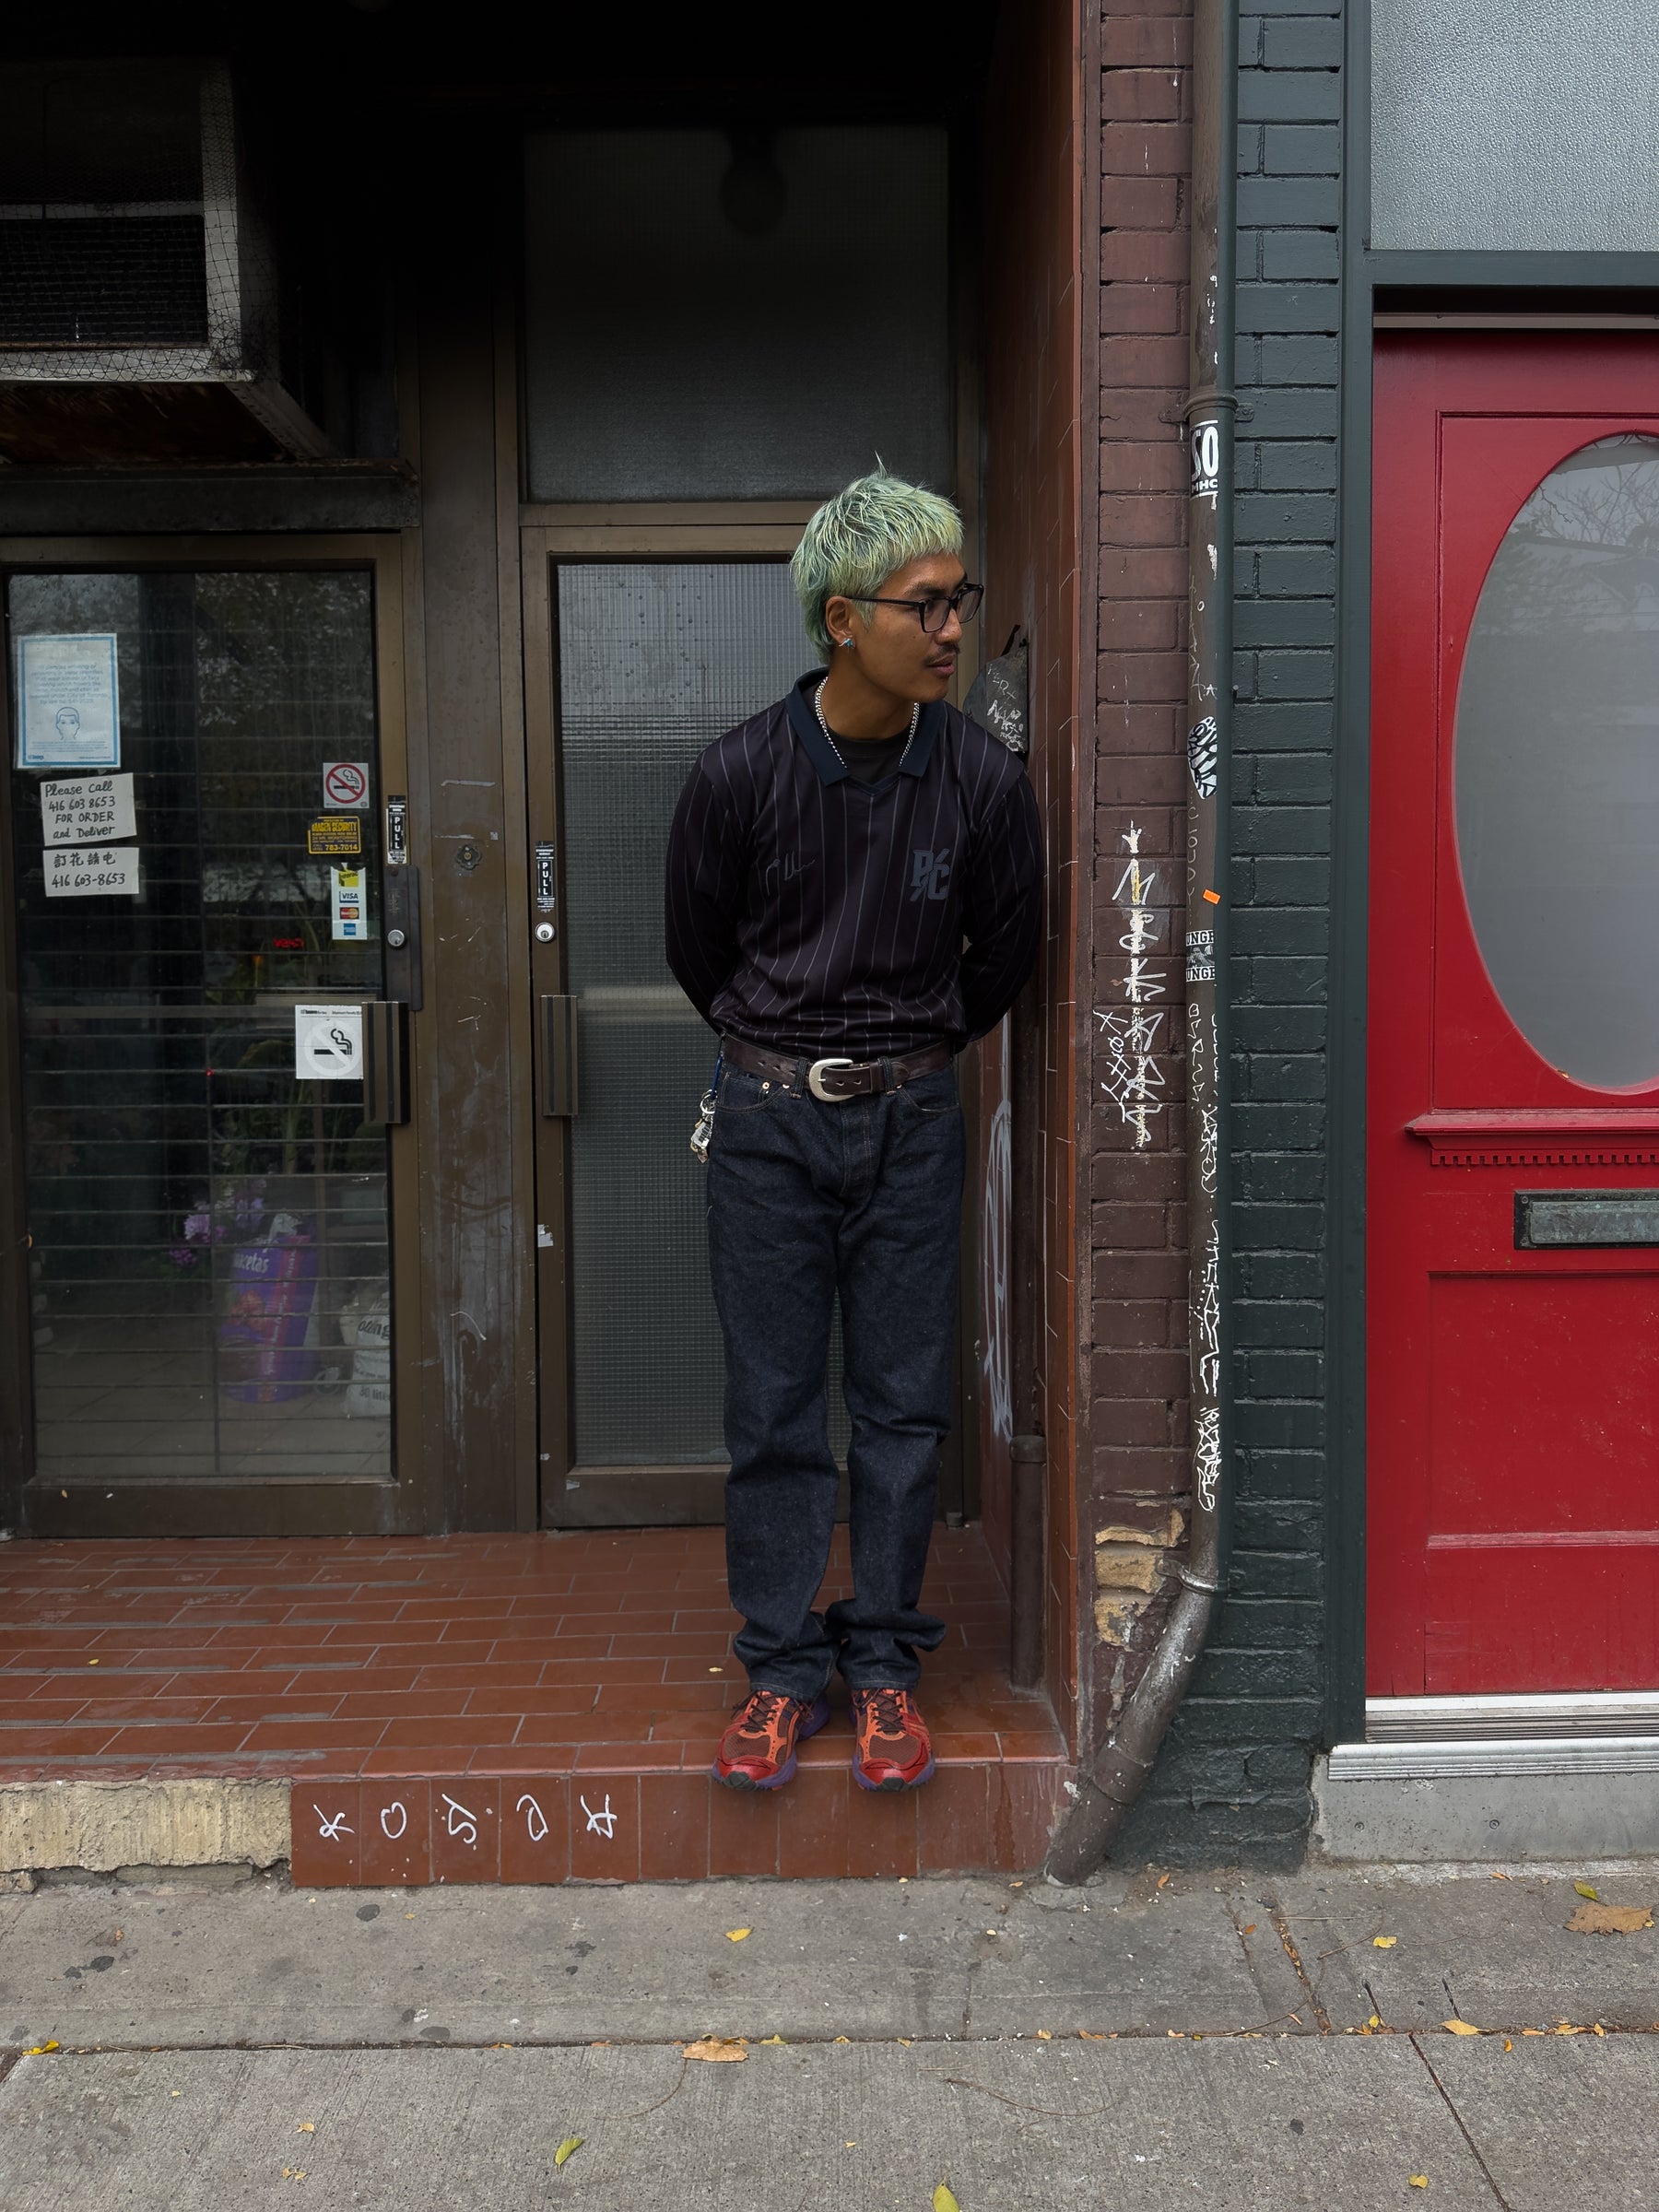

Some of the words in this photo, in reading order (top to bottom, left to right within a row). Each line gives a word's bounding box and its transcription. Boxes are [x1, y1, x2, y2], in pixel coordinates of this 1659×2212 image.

[44, 783, 82, 798] Please
[49, 800, 65, 812] 416
[69, 798, 85, 810] 603
[88, 795, 115, 808] 8653
[55, 813, 73, 824] FOR
[78, 811, 114, 823] ORDER
[53, 828, 71, 839] and
[76, 826, 115, 838] Deliver
[52, 874, 70, 888] 416
[75, 873, 125, 887] 603-8653
